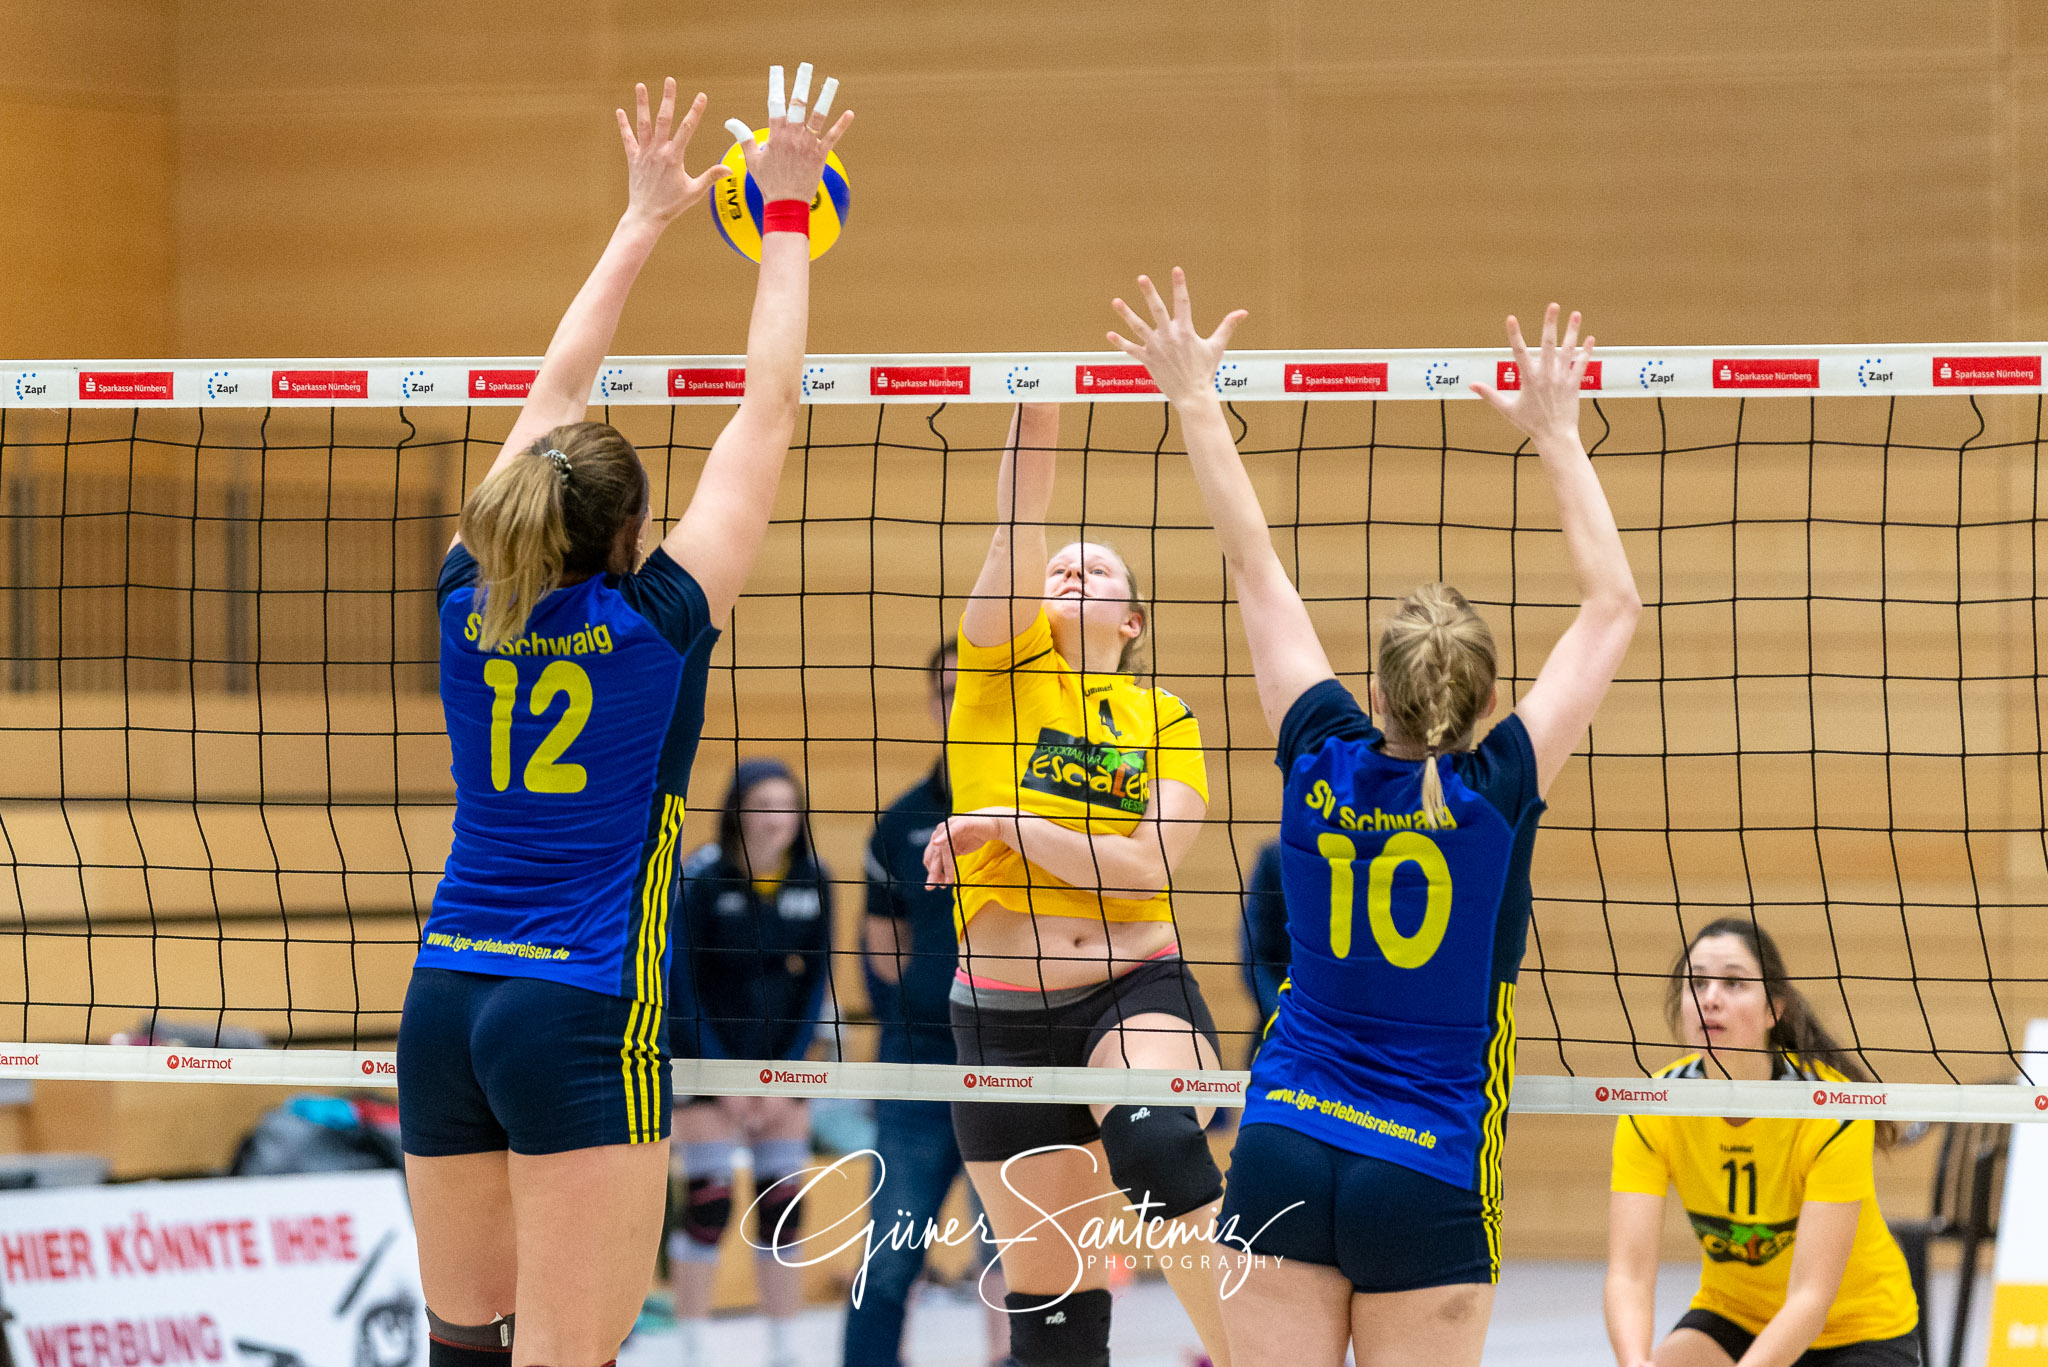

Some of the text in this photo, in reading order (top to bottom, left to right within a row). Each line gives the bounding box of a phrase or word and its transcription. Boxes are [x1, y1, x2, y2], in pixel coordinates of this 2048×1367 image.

[1650, 373, 1674, 384] Zapf
[1734, 371, 1812, 382] Sparkasse Nürnberg
[1868, 371, 1893, 382] Zapf
[1954, 368, 2034, 380] Sparkasse Nürnberg
[291, 381, 361, 392] Sparkasse Nürnberg
[688, 380, 724, 390] Sparkasse
[811, 380, 835, 391] Zapf
[890, 378, 964, 389] Sparkasse Nürnberg
[1016, 379, 1040, 390] Zapf
[1096, 377, 1134, 388] Sparkasse
[1224, 377, 1248, 388] Zapf
[1305, 375, 1381, 386] Sparkasse Nürnberg
[1435, 375, 1459, 386] Zapf
[24, 384, 47, 396] Zapf
[98, 384, 167, 394] Sparkasse Nürnberg
[216, 383, 238, 395] Zapf
[411, 383, 434, 394] Zapf
[488, 382, 524, 392] Sparkasse
[610, 381, 633, 393] Zapf
[1098, 697, 1122, 740] 4
[484, 658, 594, 794] 12
[1305, 779, 1336, 820] SV
[1339, 803, 1458, 832] Schwag
[1317, 831, 1453, 969] 10
[0, 1054, 39, 1066] armot
[181, 1056, 231, 1070] Marmot
[775, 1070, 827, 1084] Marmot
[979, 1075, 1032, 1088] Marmot
[1187, 1079, 1240, 1093] Marmot
[1611, 1088, 1667, 1102] Marmot
[1829, 1091, 1886, 1105] Marmot
[1266, 1088, 1437, 1150] www.ige-erlebnisreisen.de
[1722, 1159, 1756, 1215] 11
[1, 1212, 360, 1284] HIER KÖNNTE IHRE
[25, 1312, 225, 1367] WERBUNG
